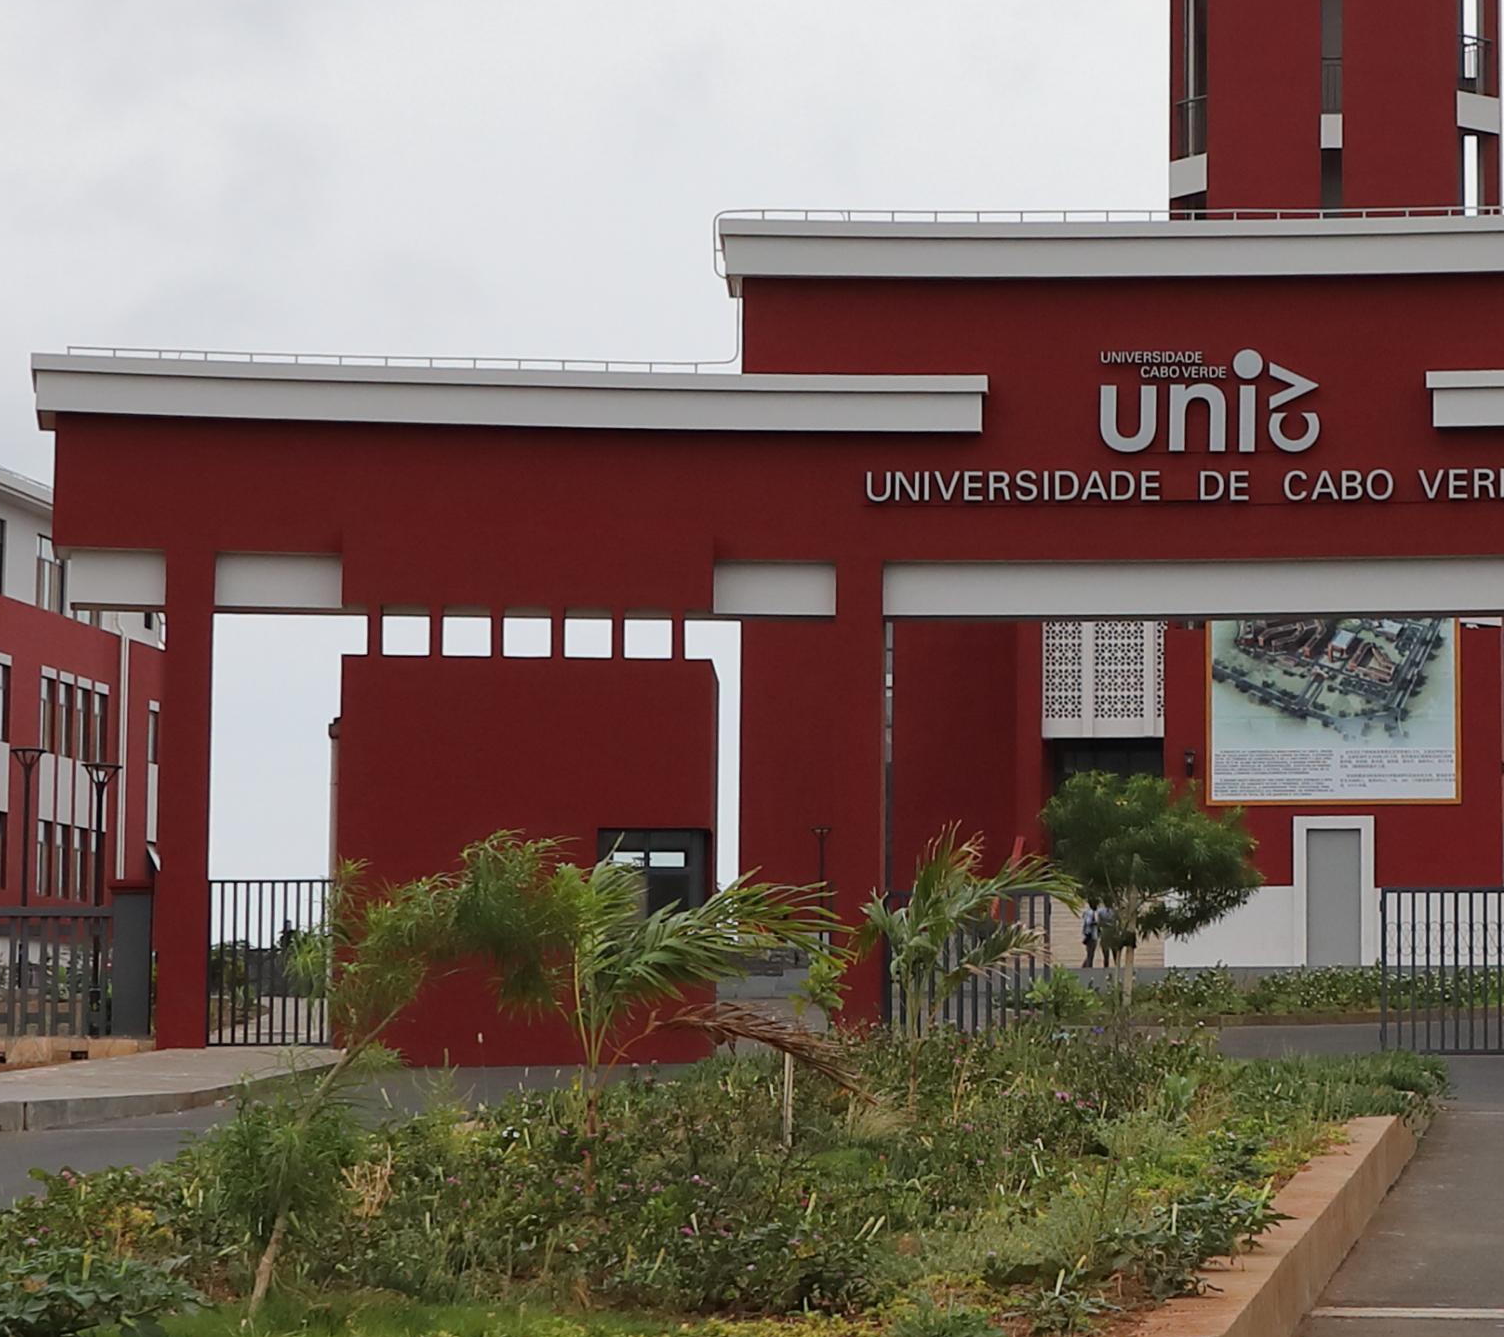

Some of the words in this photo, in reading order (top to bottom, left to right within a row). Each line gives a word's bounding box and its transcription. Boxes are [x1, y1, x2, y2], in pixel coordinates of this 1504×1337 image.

[1100, 350, 1203, 364] UNIVERSIDADE
[1140, 365, 1179, 379] CABO
[1182, 365, 1227, 379] VERDE
[865, 470, 1161, 502] UNIVERSIDADE
[1198, 470, 1250, 501] DE
[1282, 469, 1394, 501] CABO
